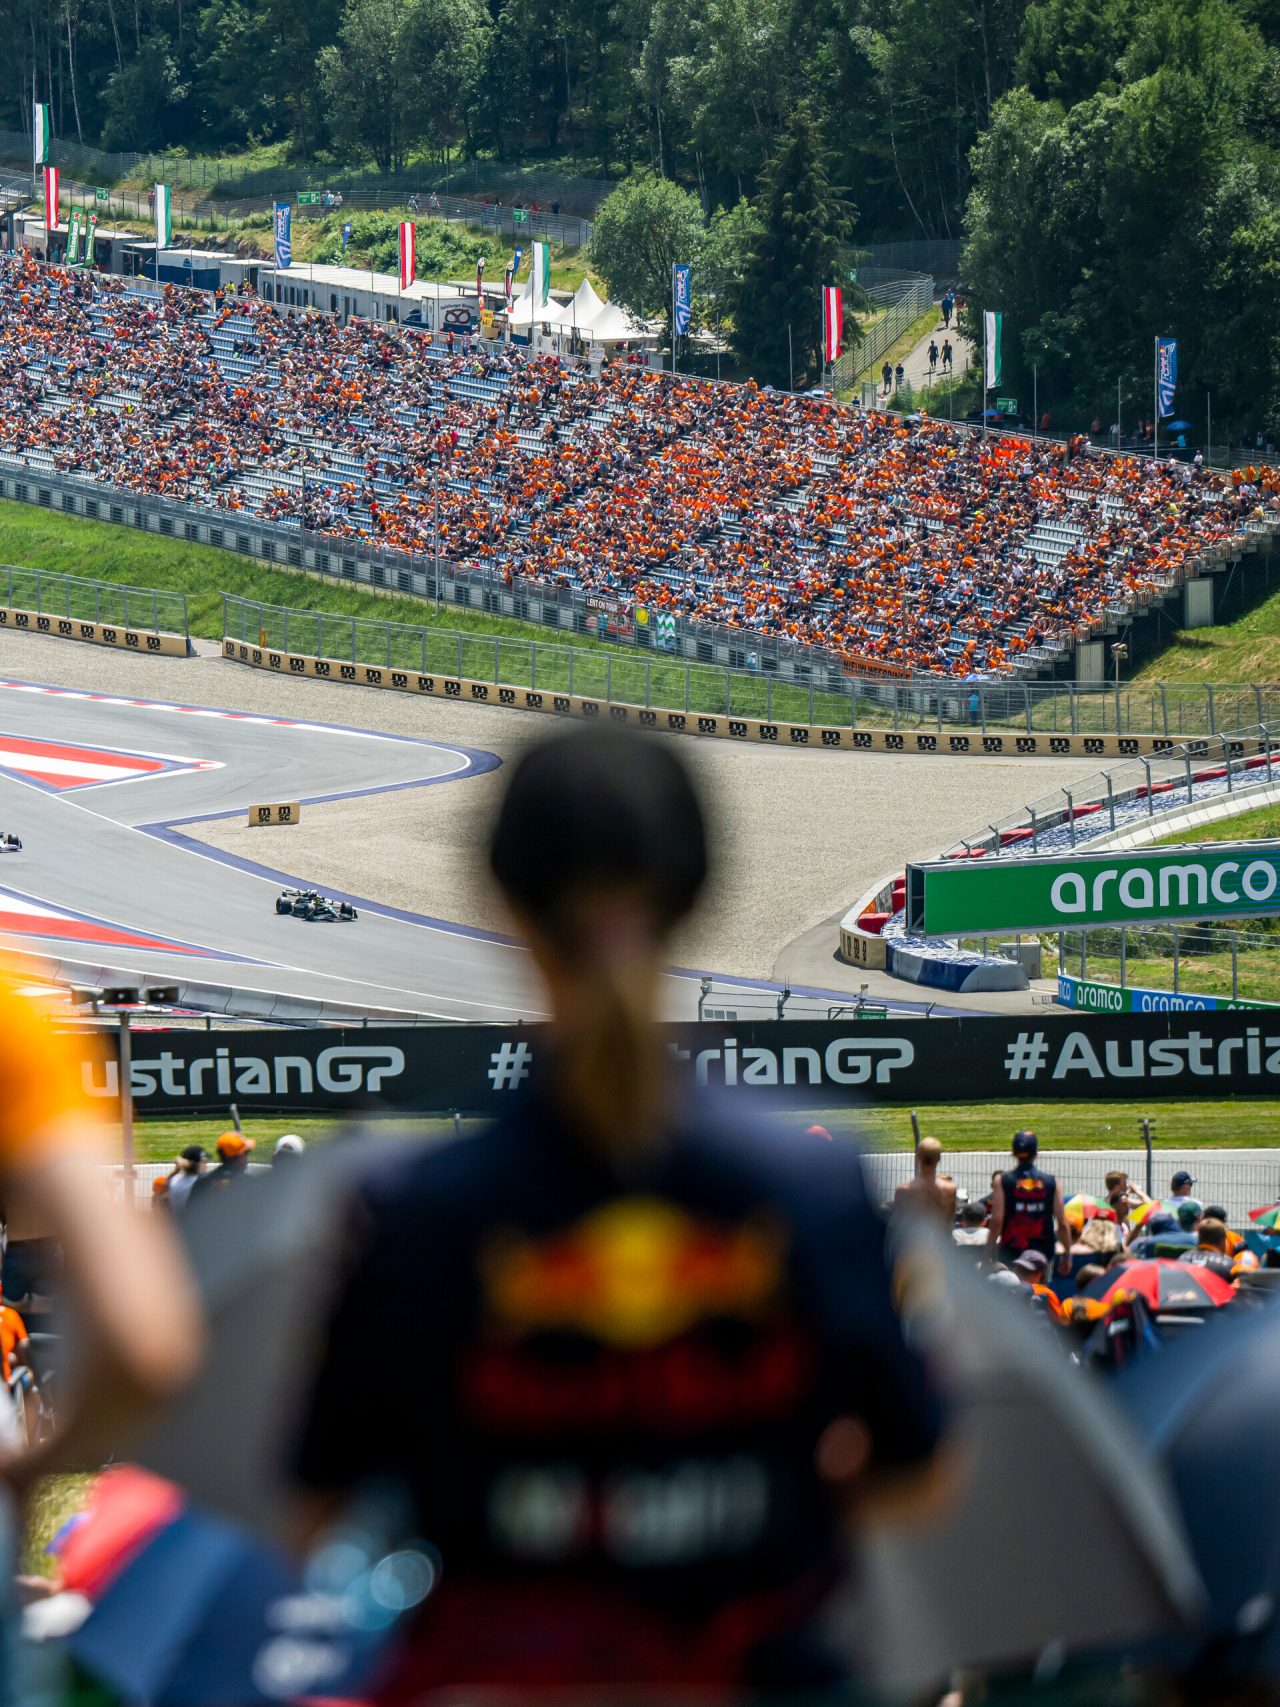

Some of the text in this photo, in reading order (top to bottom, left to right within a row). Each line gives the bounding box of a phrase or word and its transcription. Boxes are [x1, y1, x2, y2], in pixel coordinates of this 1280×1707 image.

[1050, 860, 1277, 913] aramco
[1076, 985, 1123, 1011] aramco
[80, 1045, 406, 1097] ustrianGP
